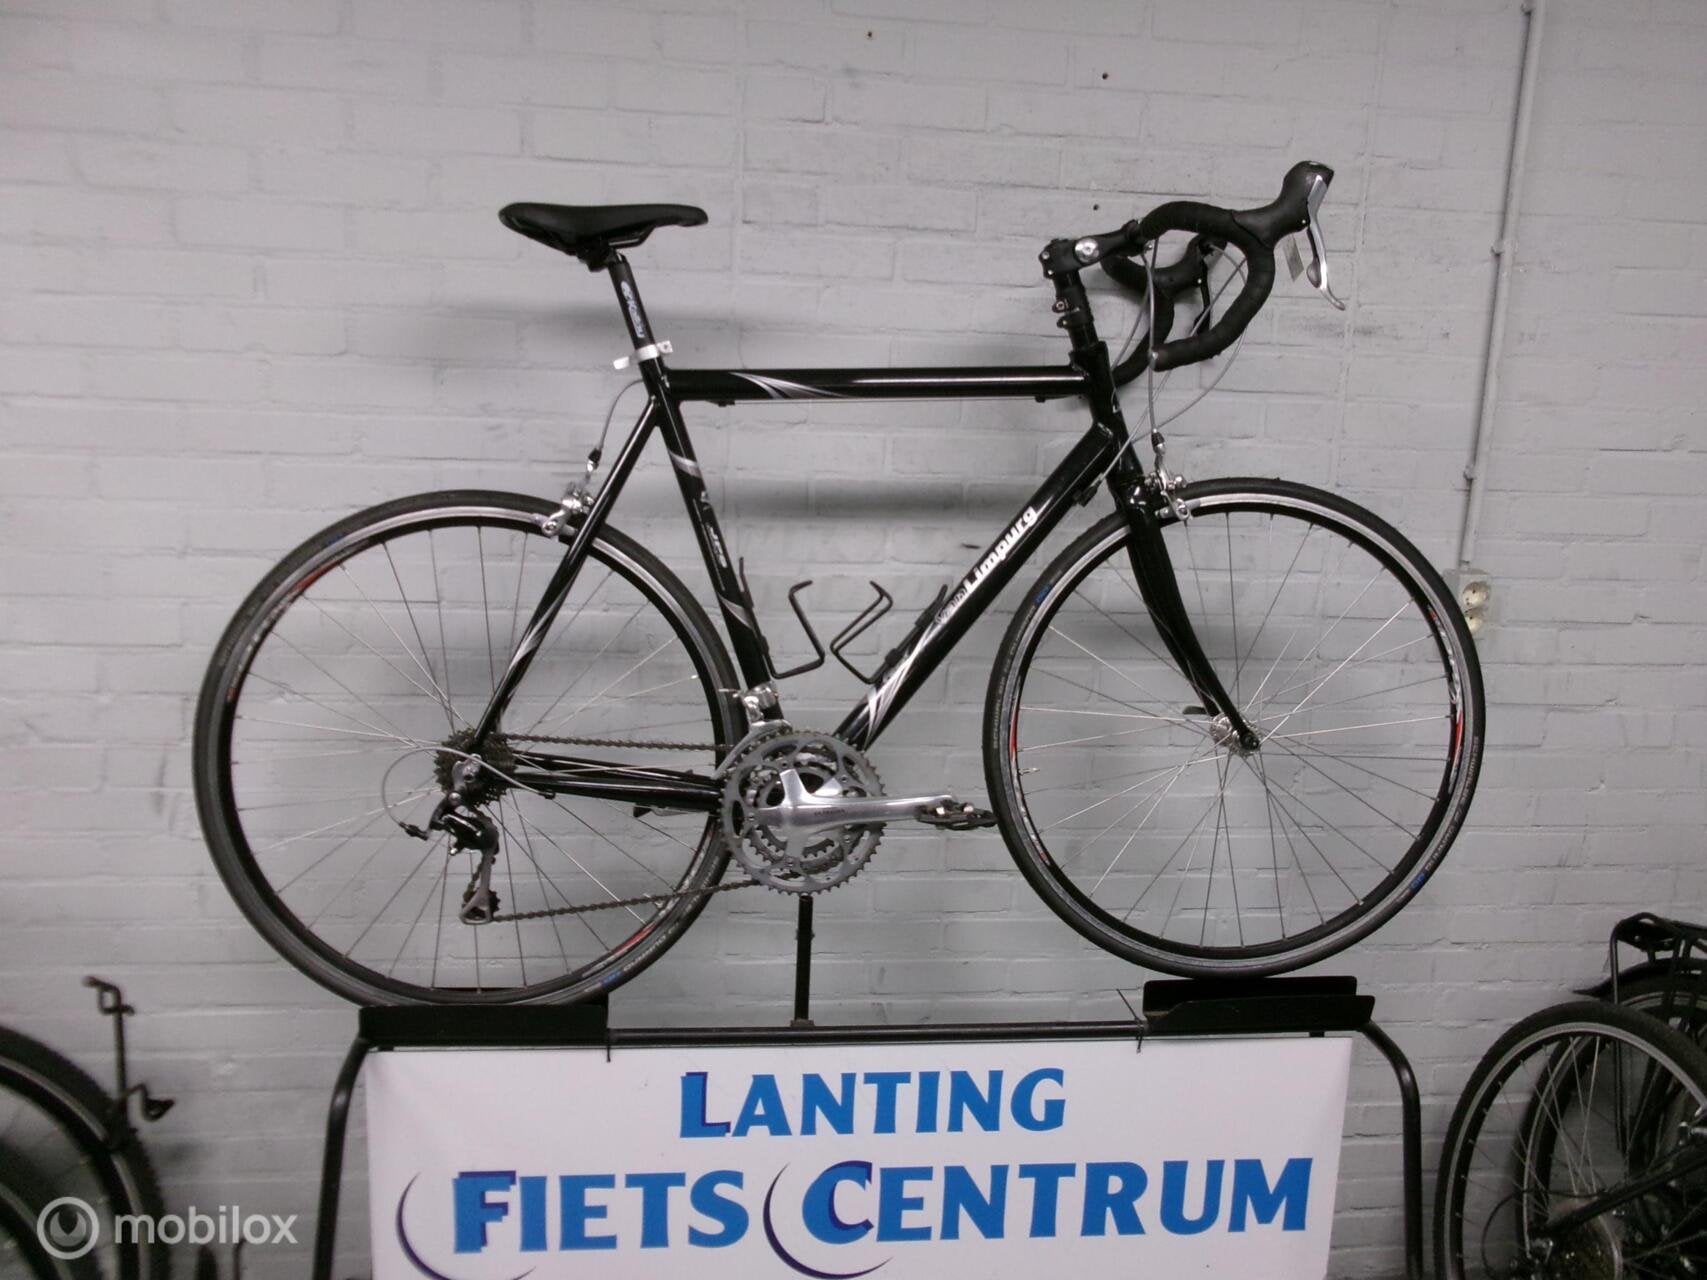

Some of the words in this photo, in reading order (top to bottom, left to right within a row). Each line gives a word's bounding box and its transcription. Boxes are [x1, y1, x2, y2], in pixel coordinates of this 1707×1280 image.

[679, 1068, 1065, 1138] LANTING
[453, 1170, 749, 1254] FIETS
[801, 1157, 1312, 1244] CENTRUM
